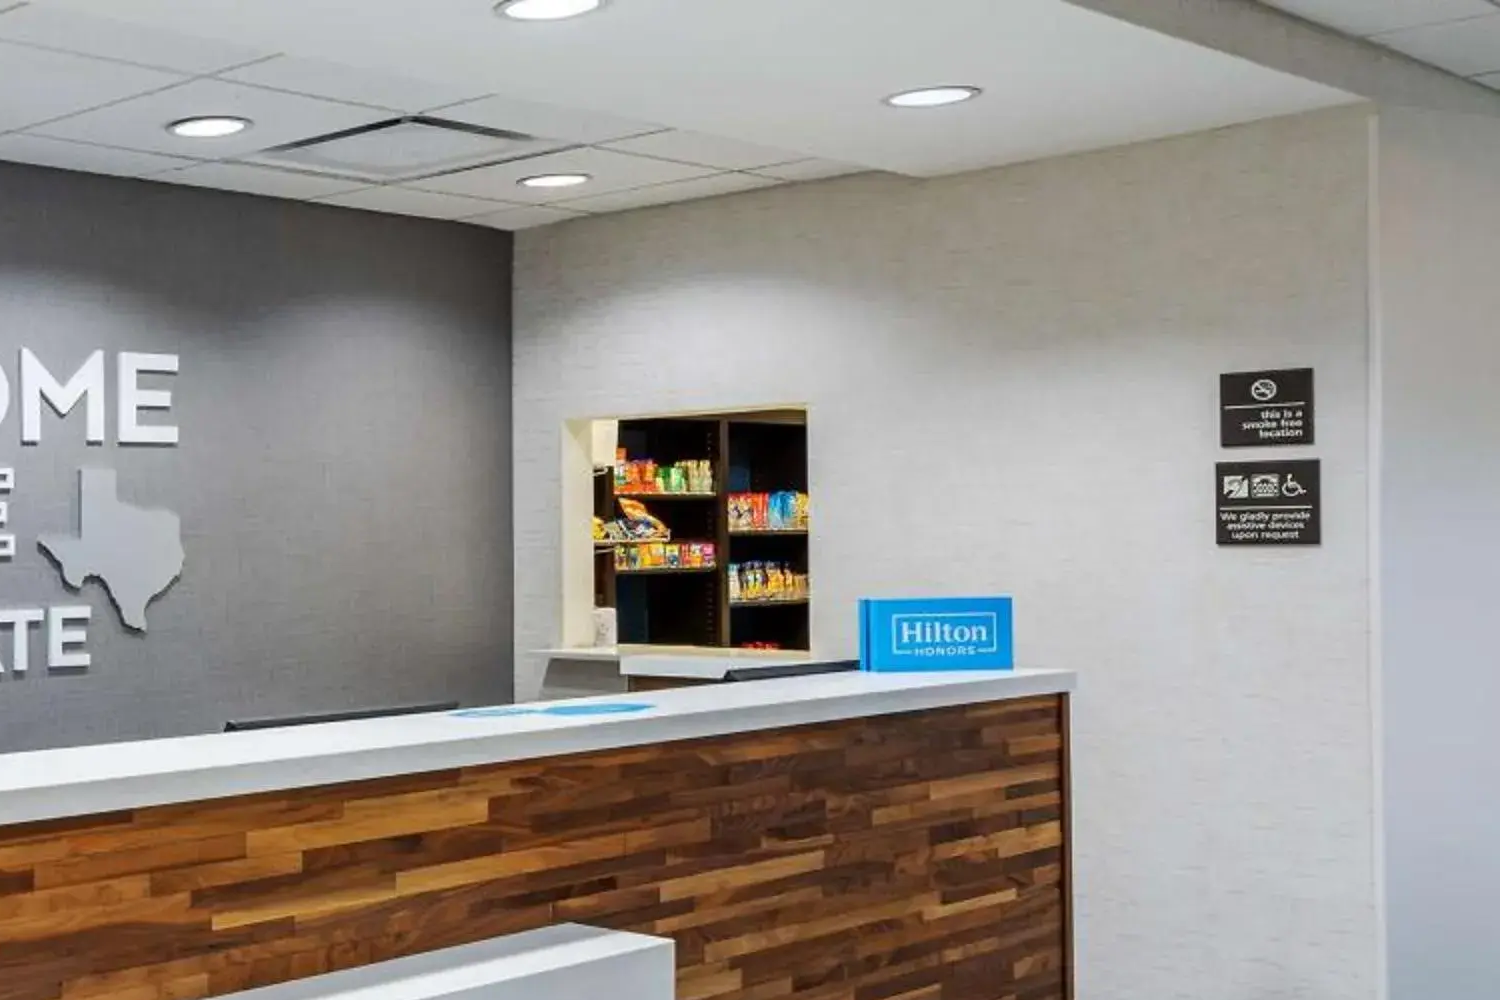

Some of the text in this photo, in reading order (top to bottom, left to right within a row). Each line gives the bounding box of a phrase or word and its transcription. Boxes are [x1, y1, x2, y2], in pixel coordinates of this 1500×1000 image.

[1261, 409, 1303, 419] this is a
[1242, 419, 1303, 430] smoke free
[1259, 428, 1303, 439] location
[901, 621, 987, 643] Hilton
[915, 646, 977, 656] HONORS
